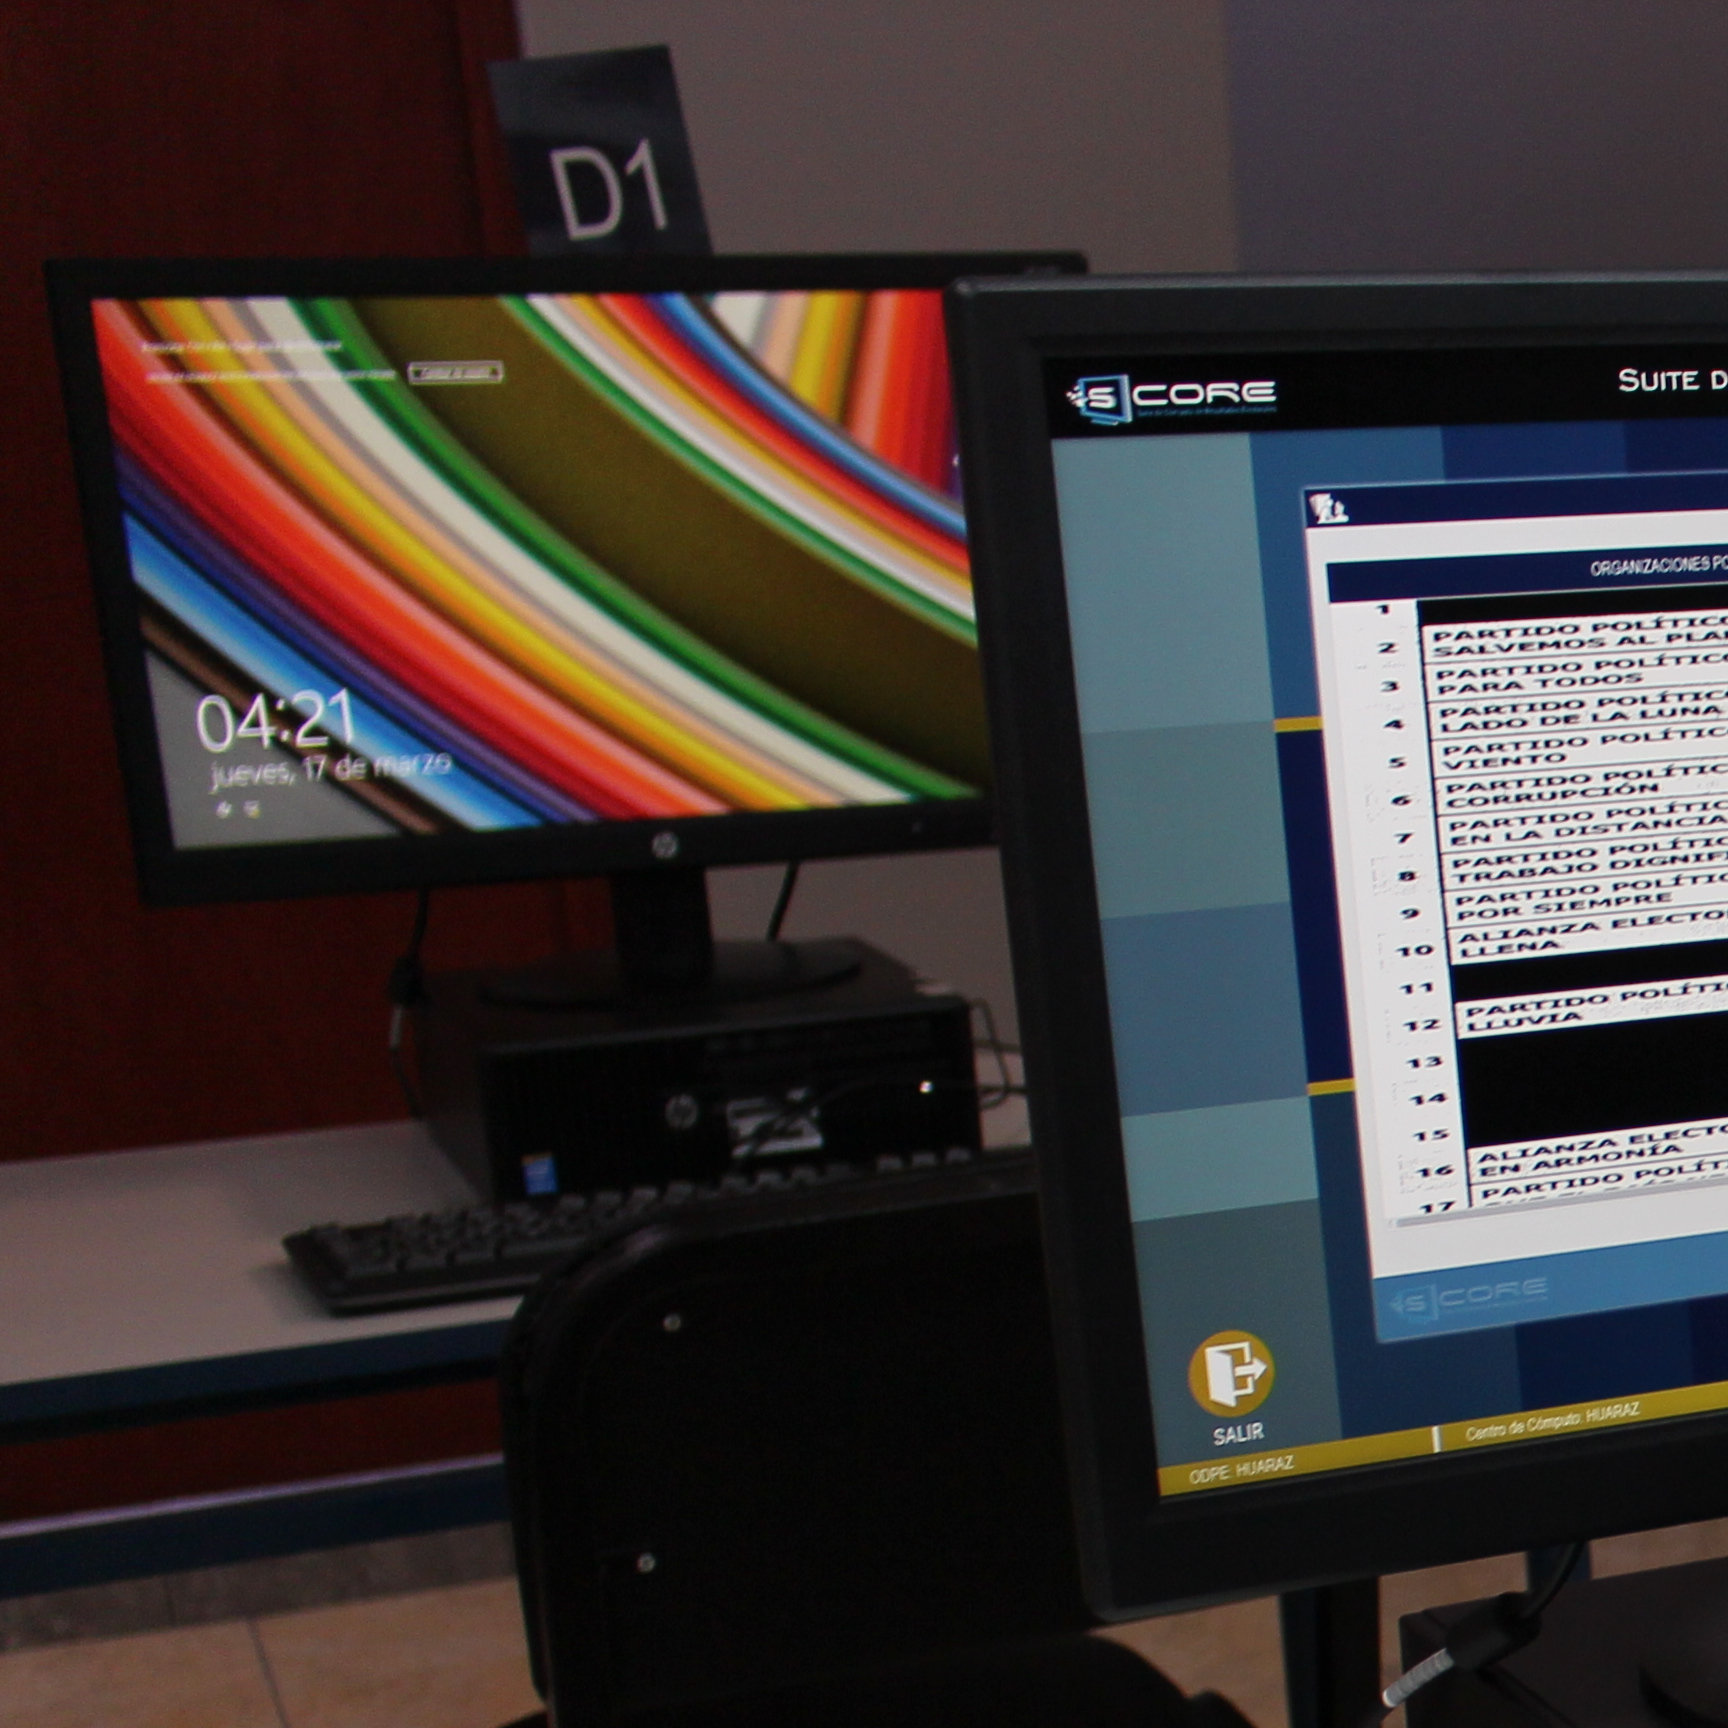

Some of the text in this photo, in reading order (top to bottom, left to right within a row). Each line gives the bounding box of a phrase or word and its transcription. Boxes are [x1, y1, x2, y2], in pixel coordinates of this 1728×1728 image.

[551, 138, 668, 241] D1
[1590, 554, 1711, 577] ORGANIZACIONES
[1376, 603, 1391, 615] 1
[1432, 623, 1581, 642] PARTIDO
[1377, 642, 1397, 654] 2
[1434, 637, 1606, 657] SALVEMOS
[1615, 634, 1655, 647] AL
[1435, 661, 1583, 680] PARTIDO
[1382, 680, 1400, 692] 3
[1437, 672, 1643, 695] PARA TODOS
[1439, 698, 1586, 718] PARTIDO
[1440, 704, 1723, 733] LADO DE LA LUNA
[196, 687, 355, 753] 04:21
[1383, 718, 1404, 730] 4
[1442, 736, 1589, 756] PARTIDO
[1388, 756, 1406, 769] 5
[1443, 752, 1567, 771] VIENTO
[208, 751, 453, 796] jueves, 17 de marzo
[1445, 773, 1593, 794] PARTIDO
[1390, 794, 1412, 807] 6
[1445, 779, 1659, 809] CORRUPCIÓN
[1449, 810, 1595, 831] PARTIDO
[1450, 813, 1728, 847] EN LA DISTANCIA
[1396, 832, 1414, 844] 7
[1451, 847, 1598, 869] PARTIDO
[1397, 869, 1417, 882] 8
[1453, 861, 1599, 884] TRABAJO
[1455, 884, 1600, 907] PARTIDO
[1399, 907, 1421, 920] 9
[1456, 891, 1671, 922] POR SIEMPRE
[1457, 921, 1600, 944] ALIANZA
[1396, 943, 1435, 958] 10
[1460, 939, 1561, 959] LLENA
[1400, 981, 1434, 995] 11
[1465, 993, 1610, 1017] PARTIDO
[1403, 1017, 1440, 1032] 12
[1467, 1010, 1582, 1032] LLUVIA
[1407, 1054, 1443, 1069] 13
[1410, 1091, 1448, 1107] 14
[1413, 1128, 1449, 1143] 15
[1477, 1137, 1618, 1164] ALIANZA
[1479, 1140, 1683, 1178] EN ARMONÍA
[1416, 1164, 1455, 1179] 16
[1481, 1172, 1624, 1199] PARTIDO
[1465, 1420, 1507, 1442] Centro
[1511, 1418, 1524, 1435] de
[1585, 1400, 1642, 1424] HUARAZ
[1212, 1421, 1265, 1447] SALIR
[1235, 1455, 1295, 1481] HUARAZ
